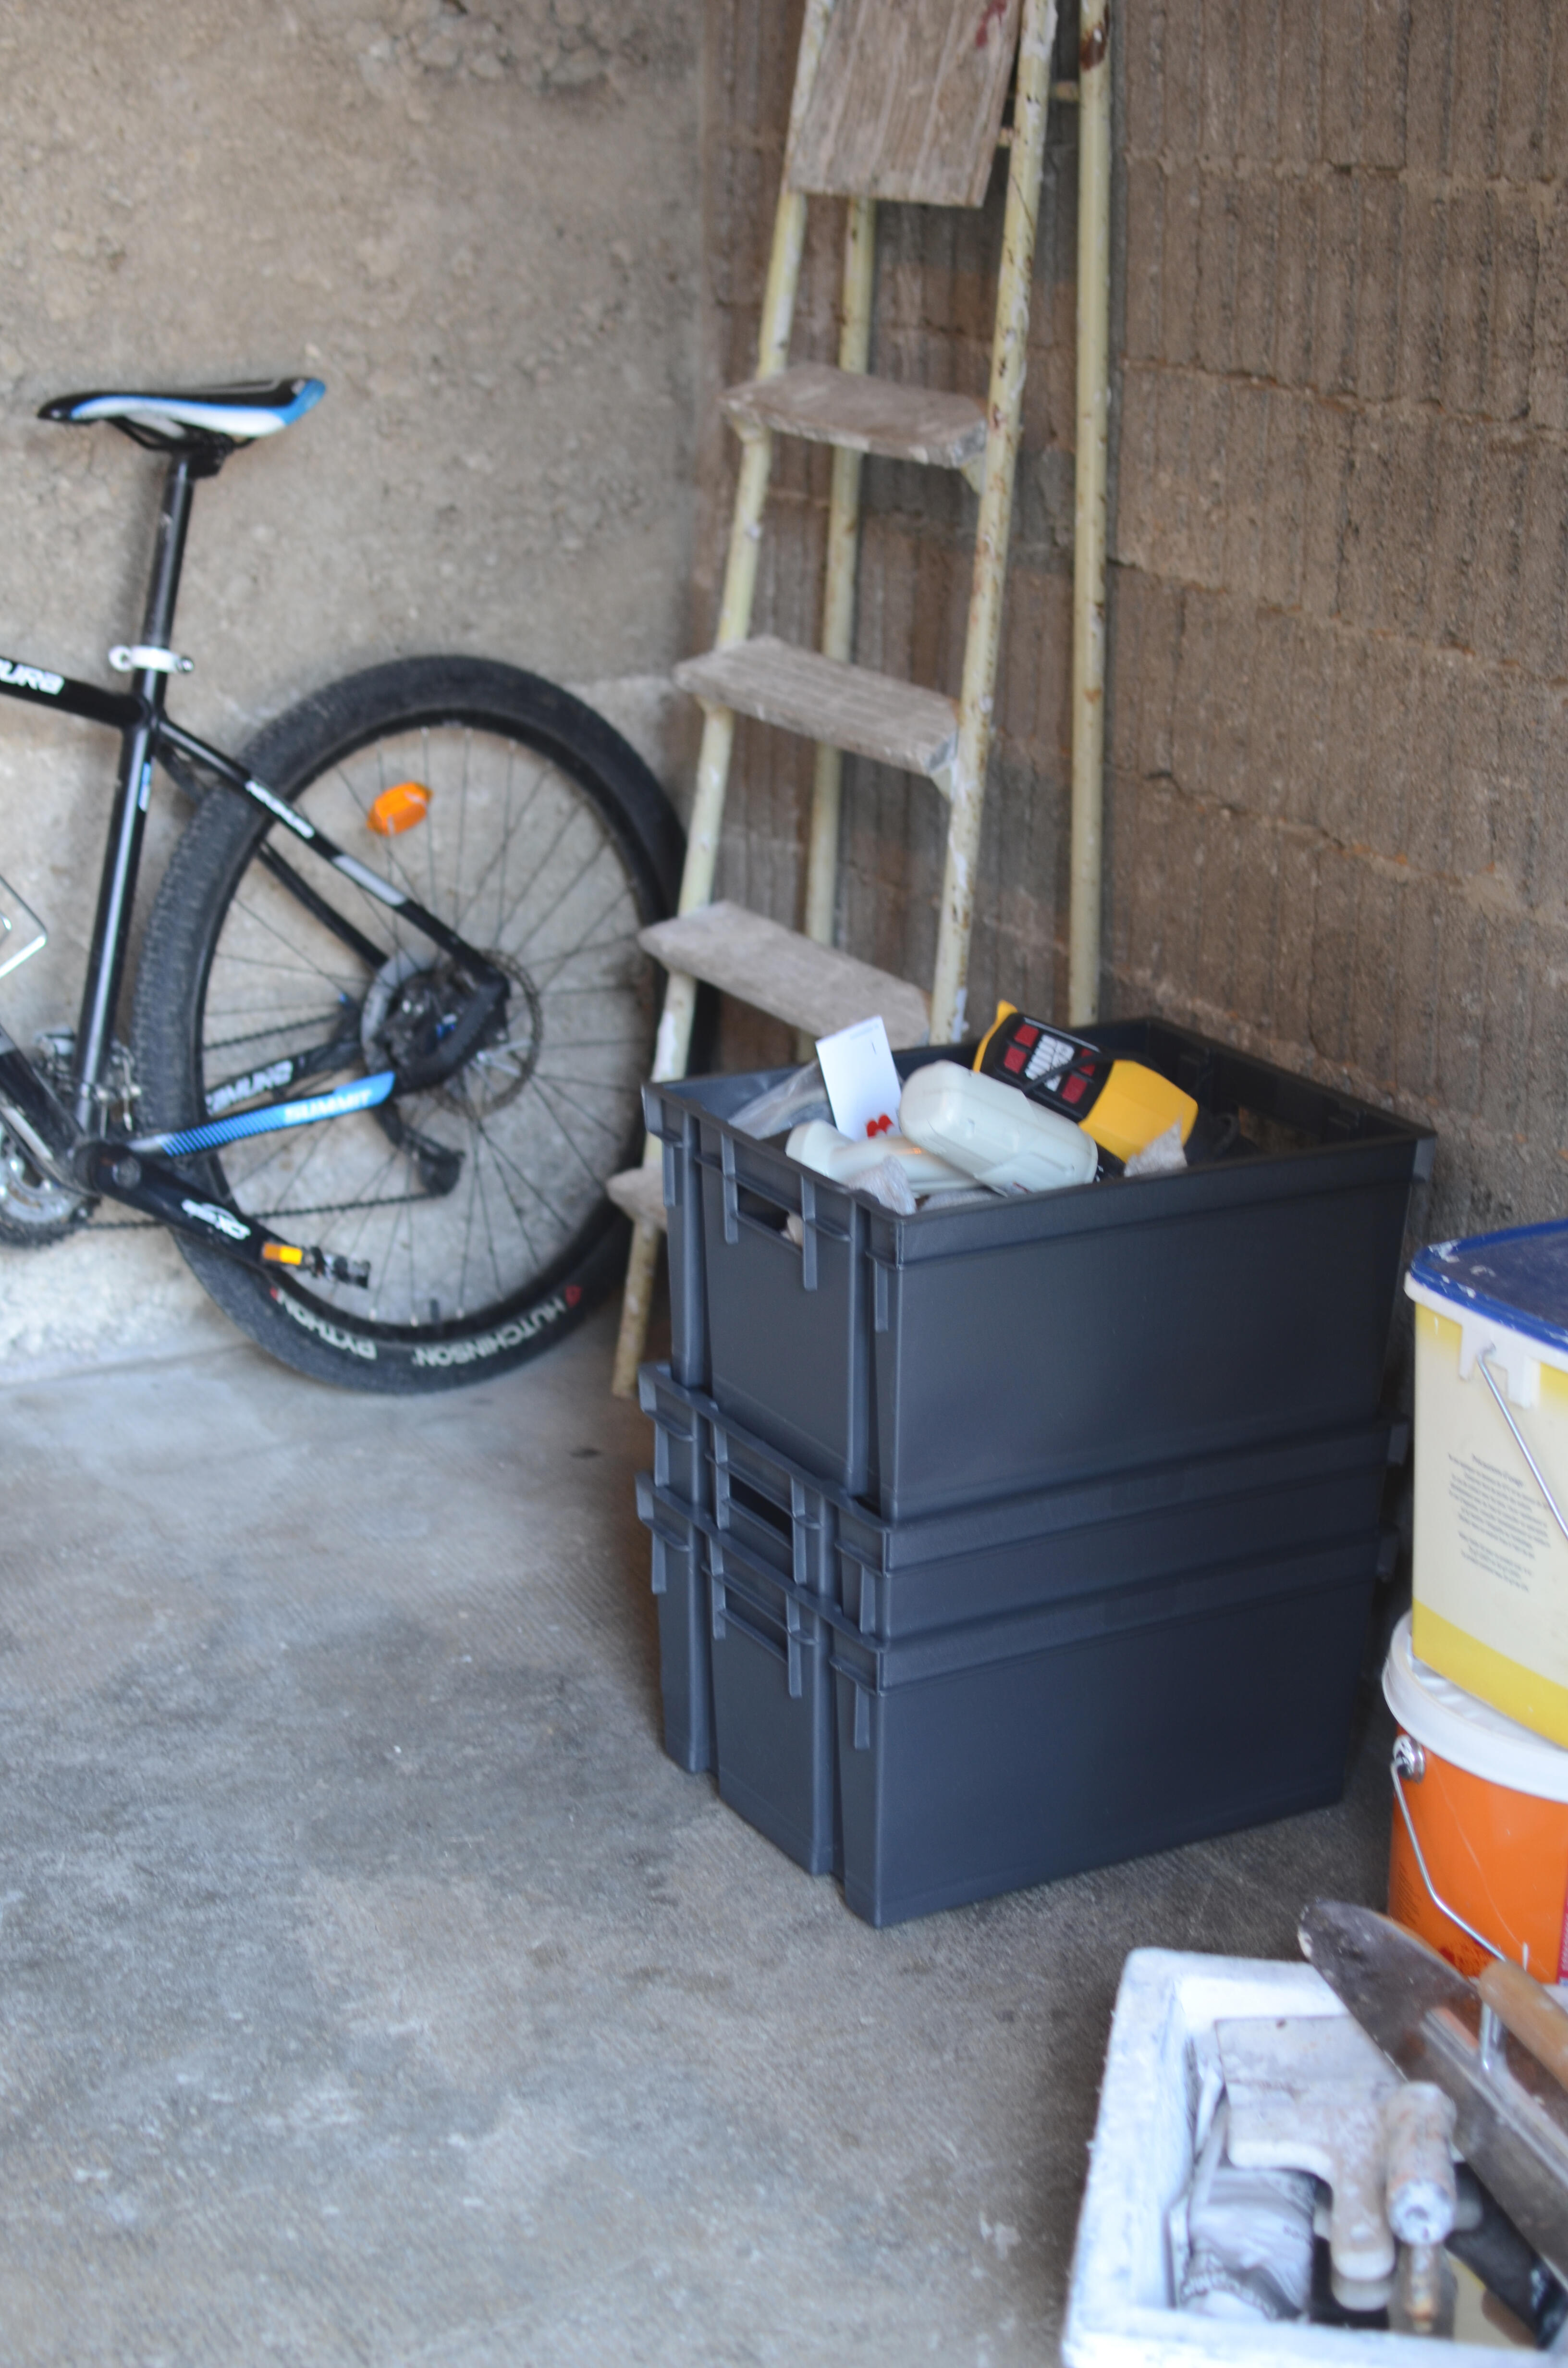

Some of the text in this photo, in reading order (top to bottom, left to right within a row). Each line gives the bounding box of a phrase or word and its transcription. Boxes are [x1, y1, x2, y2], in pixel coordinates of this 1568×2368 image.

[284, 1089, 372, 1123] SUMMIT
[277, 1288, 377, 1360] PYTHON
[414, 1297, 566, 1367] HUTCHINSON
